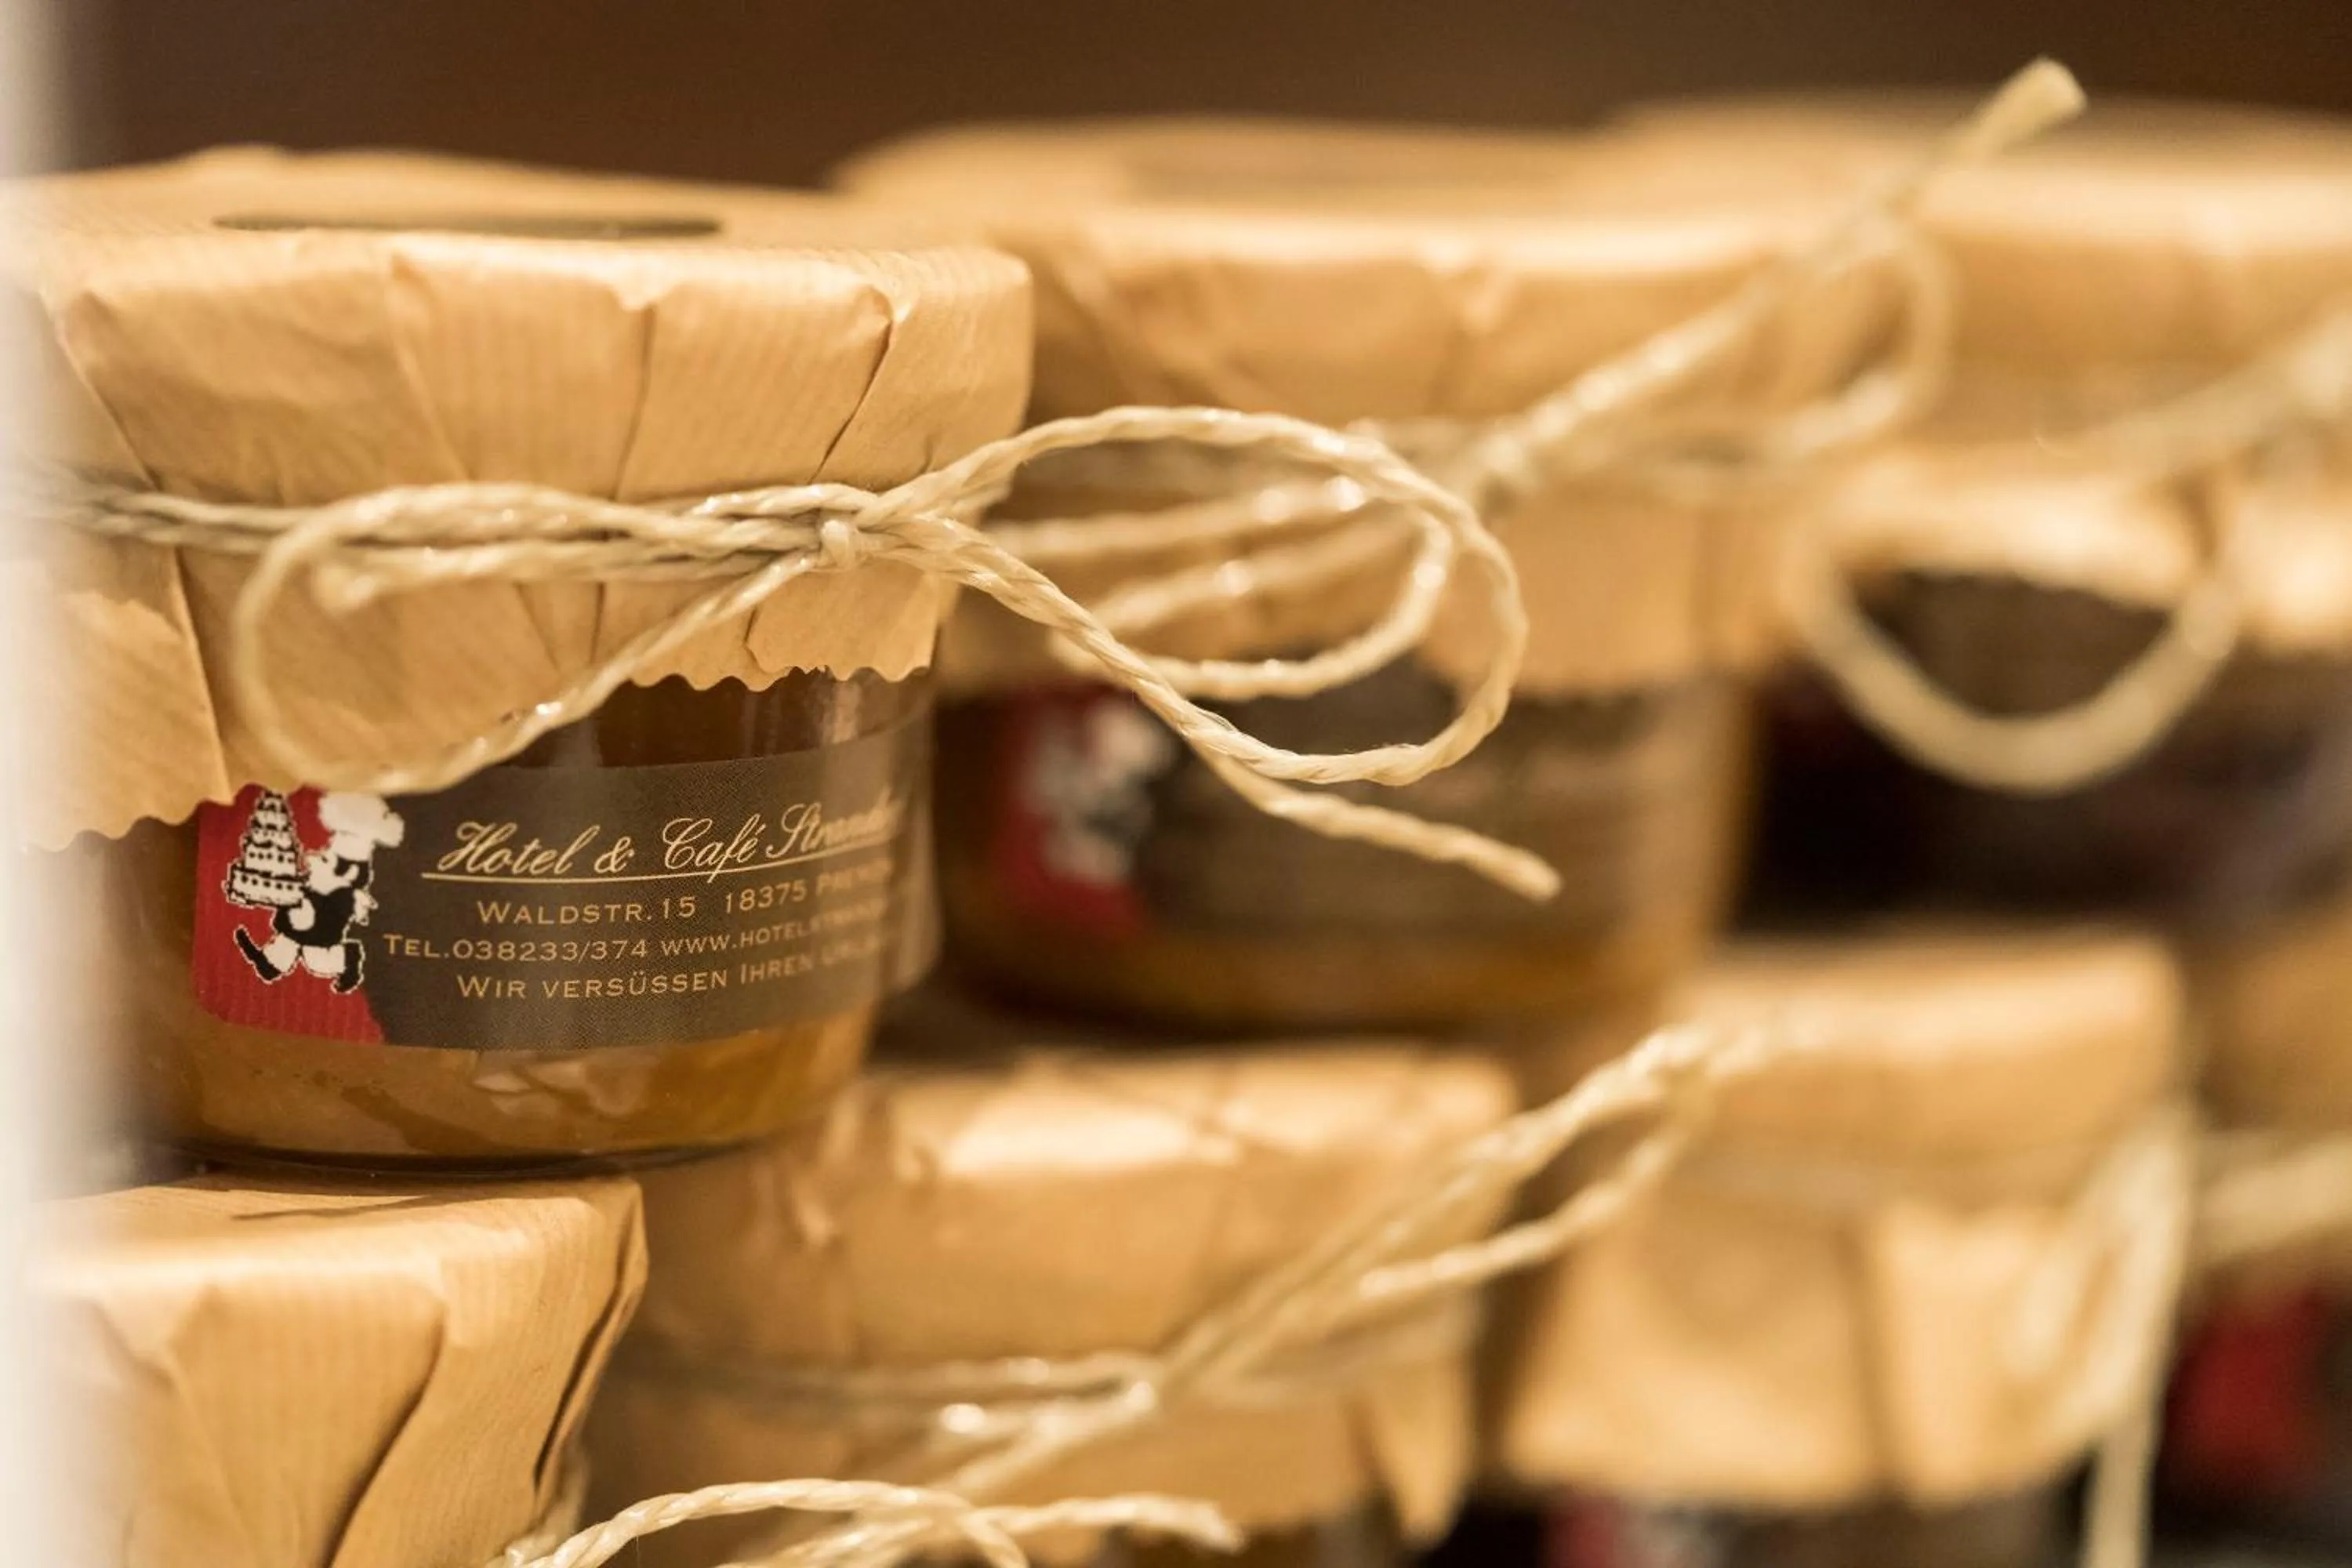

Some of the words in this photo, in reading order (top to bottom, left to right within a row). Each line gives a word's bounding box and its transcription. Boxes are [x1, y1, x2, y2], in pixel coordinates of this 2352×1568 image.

[437, 820, 601, 875] Hotel
[594, 836, 636, 874] &
[662, 812, 767, 884] Café
[726, 880, 807, 913] 18375
